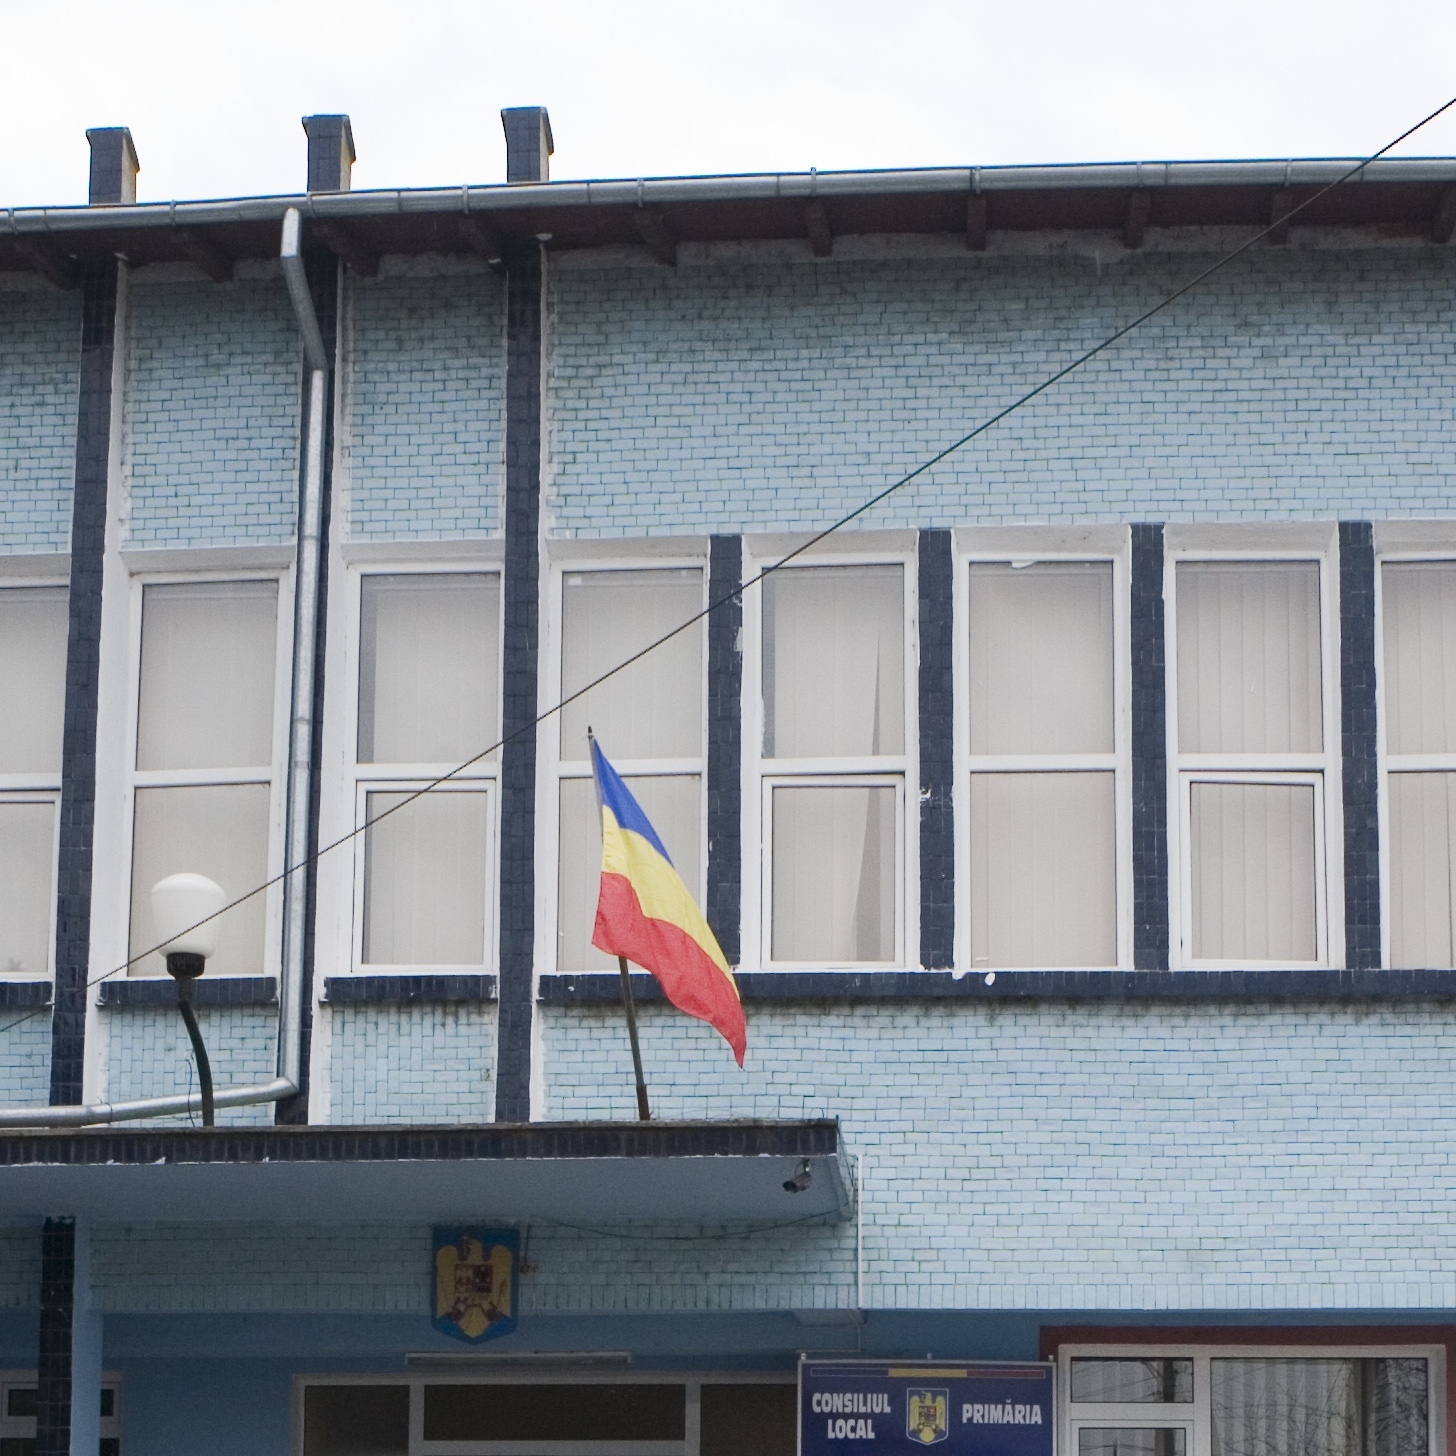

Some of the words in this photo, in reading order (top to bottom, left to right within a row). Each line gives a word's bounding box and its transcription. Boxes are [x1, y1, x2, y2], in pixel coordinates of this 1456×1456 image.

[812, 1393, 891, 1413] CONSILIUL
[962, 1398, 1042, 1425] PRIMĂRIA
[827, 1419, 875, 1439] LOCAL
